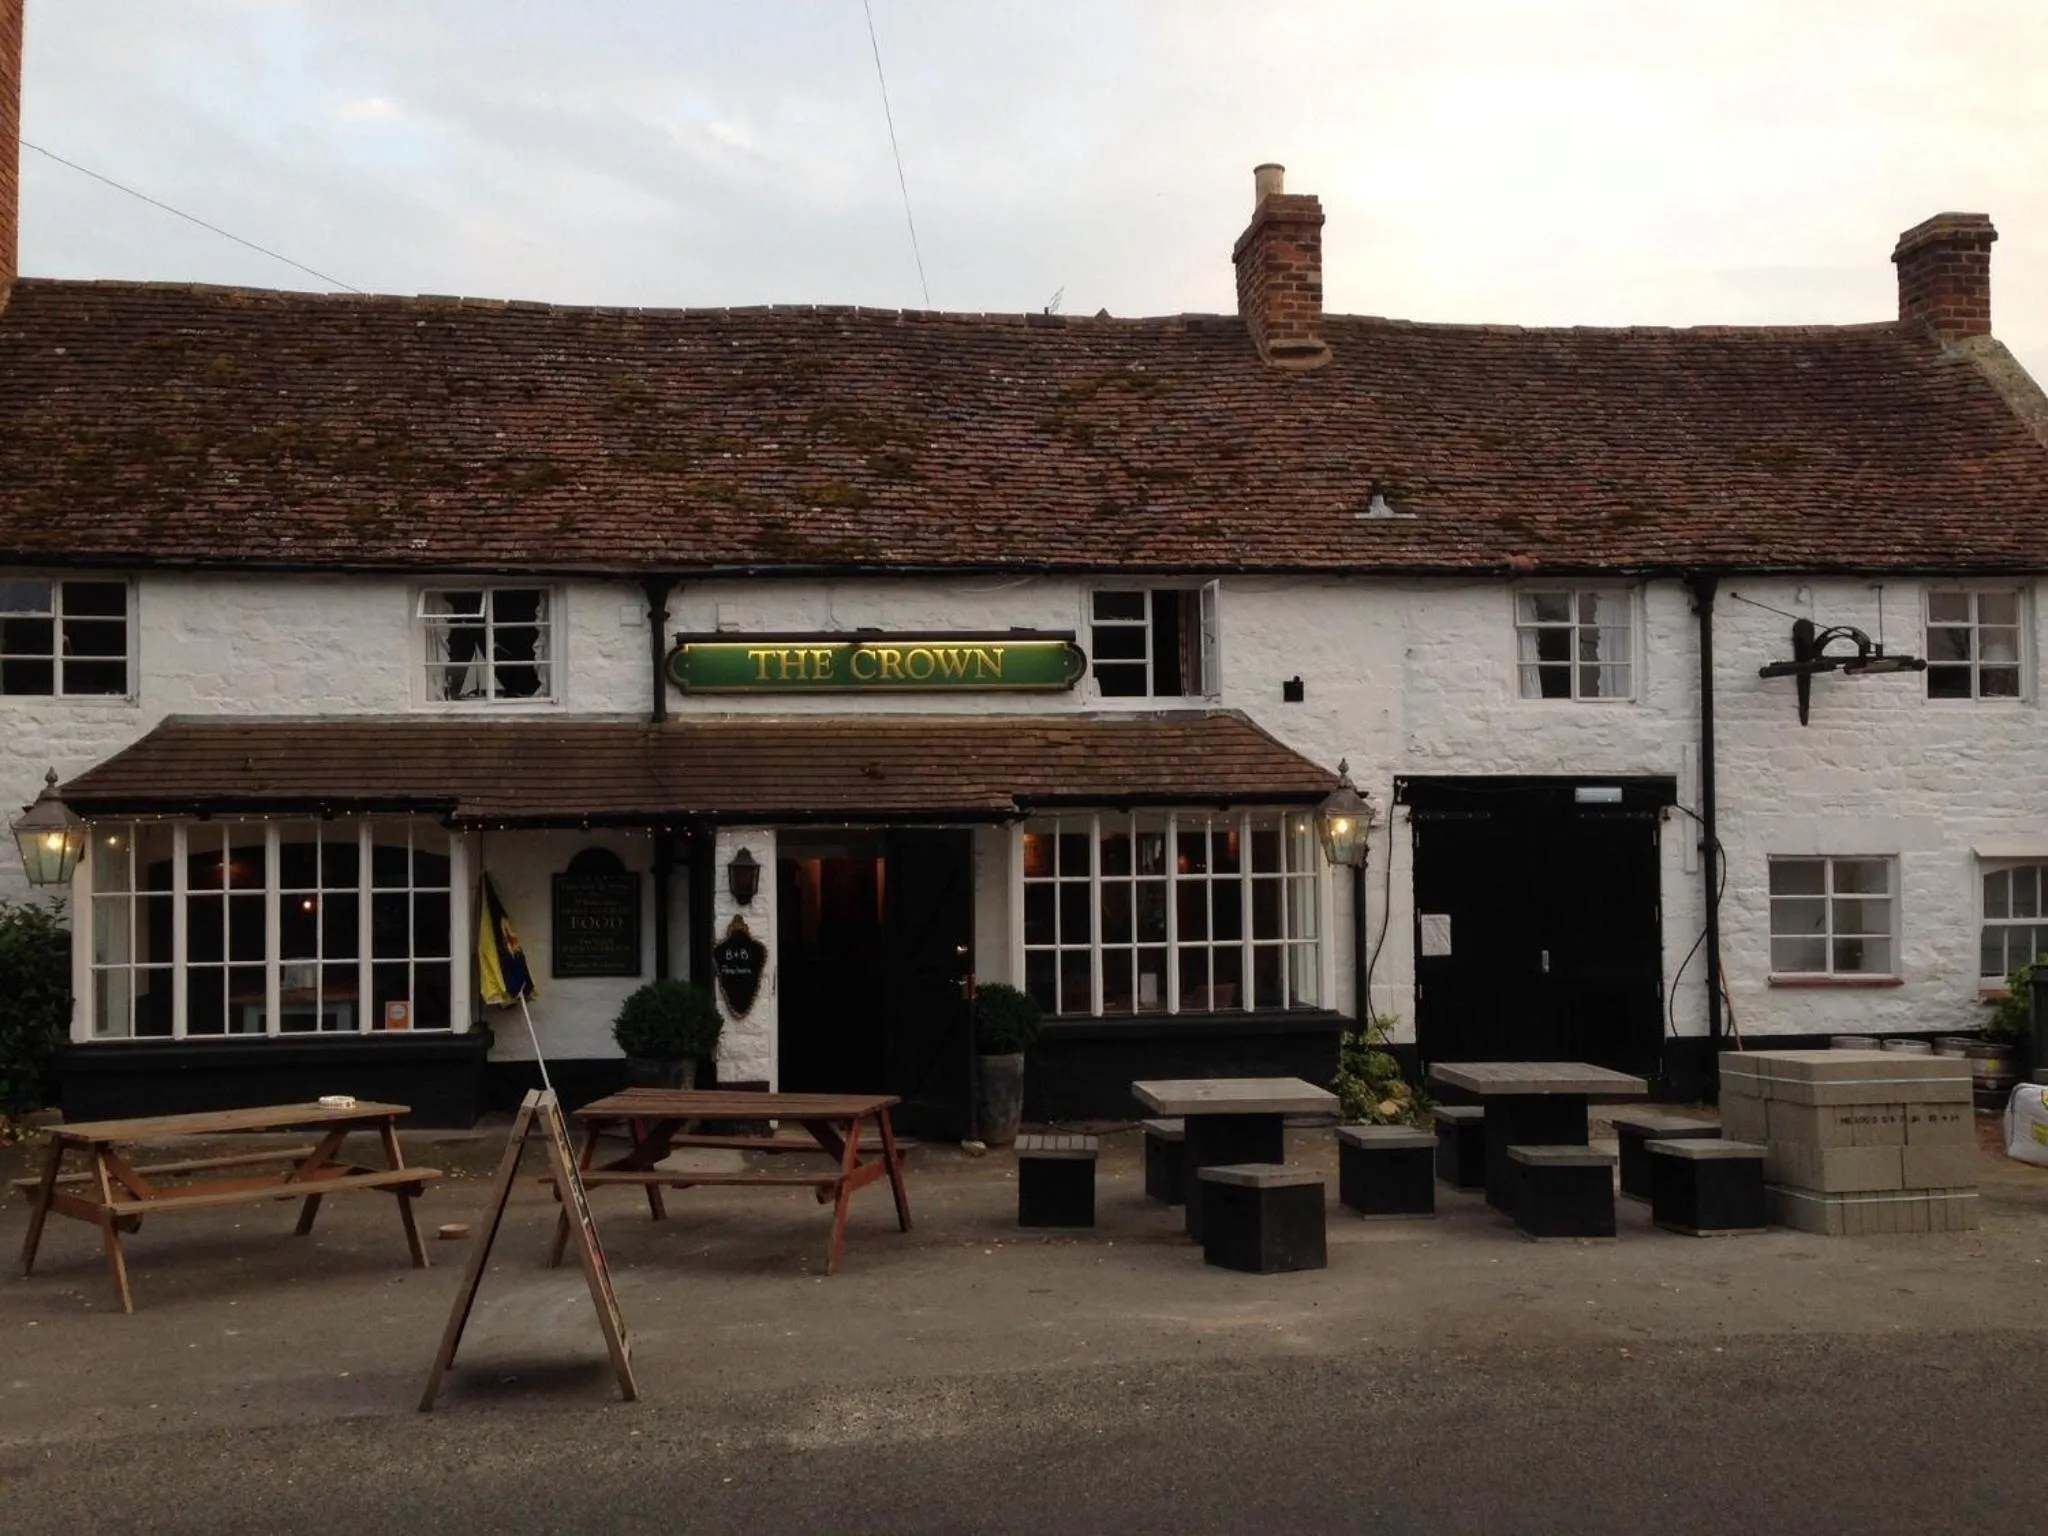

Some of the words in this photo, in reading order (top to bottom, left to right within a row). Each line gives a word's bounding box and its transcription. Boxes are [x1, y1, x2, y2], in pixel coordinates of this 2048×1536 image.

[747, 648, 835, 680] THE
[849, 647, 1005, 680] CROWN
[570, 916, 625, 930] FOOD
